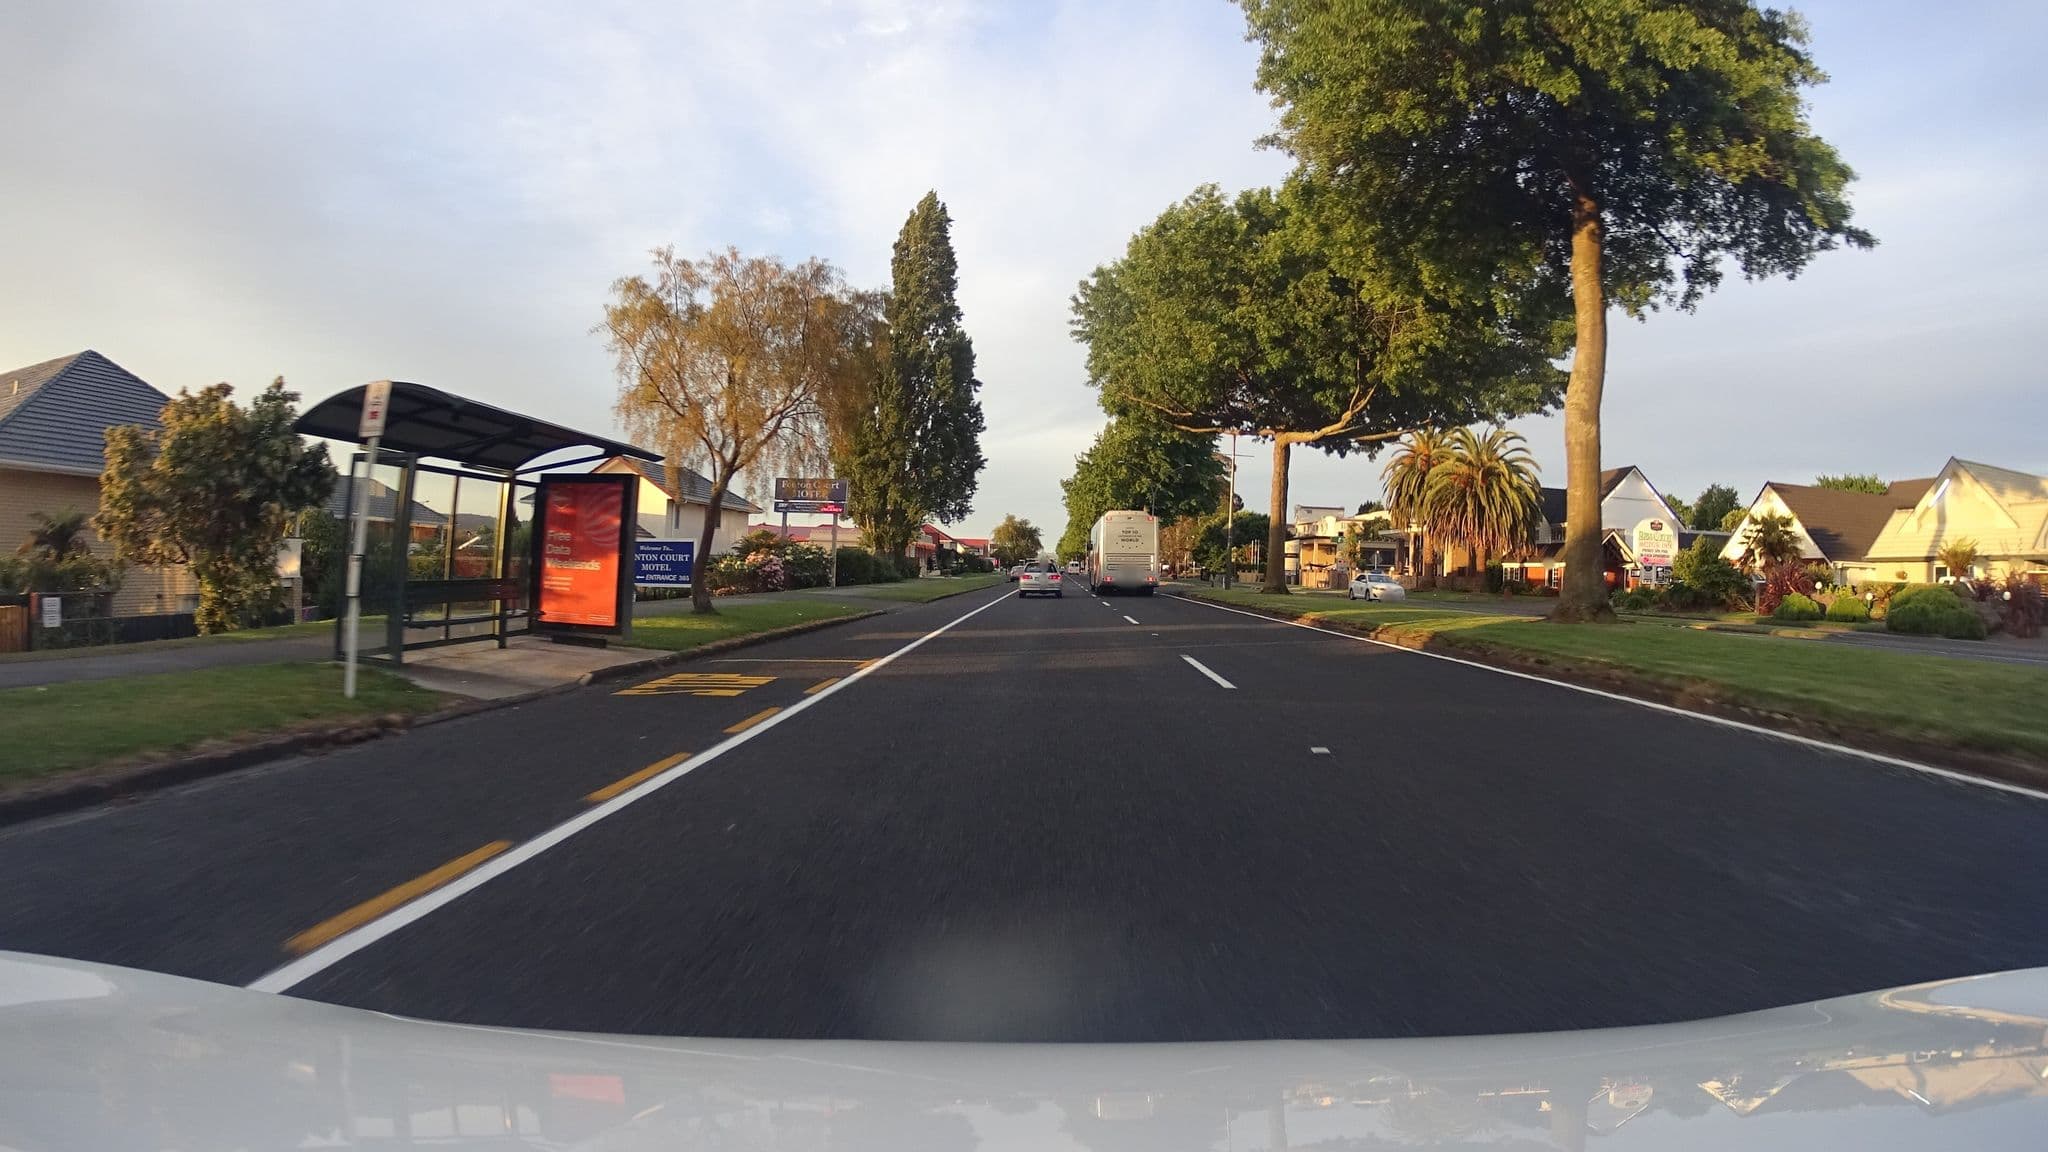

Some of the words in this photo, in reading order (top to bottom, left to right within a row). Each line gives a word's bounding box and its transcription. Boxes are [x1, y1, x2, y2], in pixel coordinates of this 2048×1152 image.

[813, 480, 839, 489] Curt
[546, 529, 572, 541] Free
[545, 544, 572, 555] Data
[634, 553, 658, 561] NTON
[659, 553, 690, 561] COURT
[545, 558, 601, 571] Weekends
[641, 563, 671, 571] MOTEL
